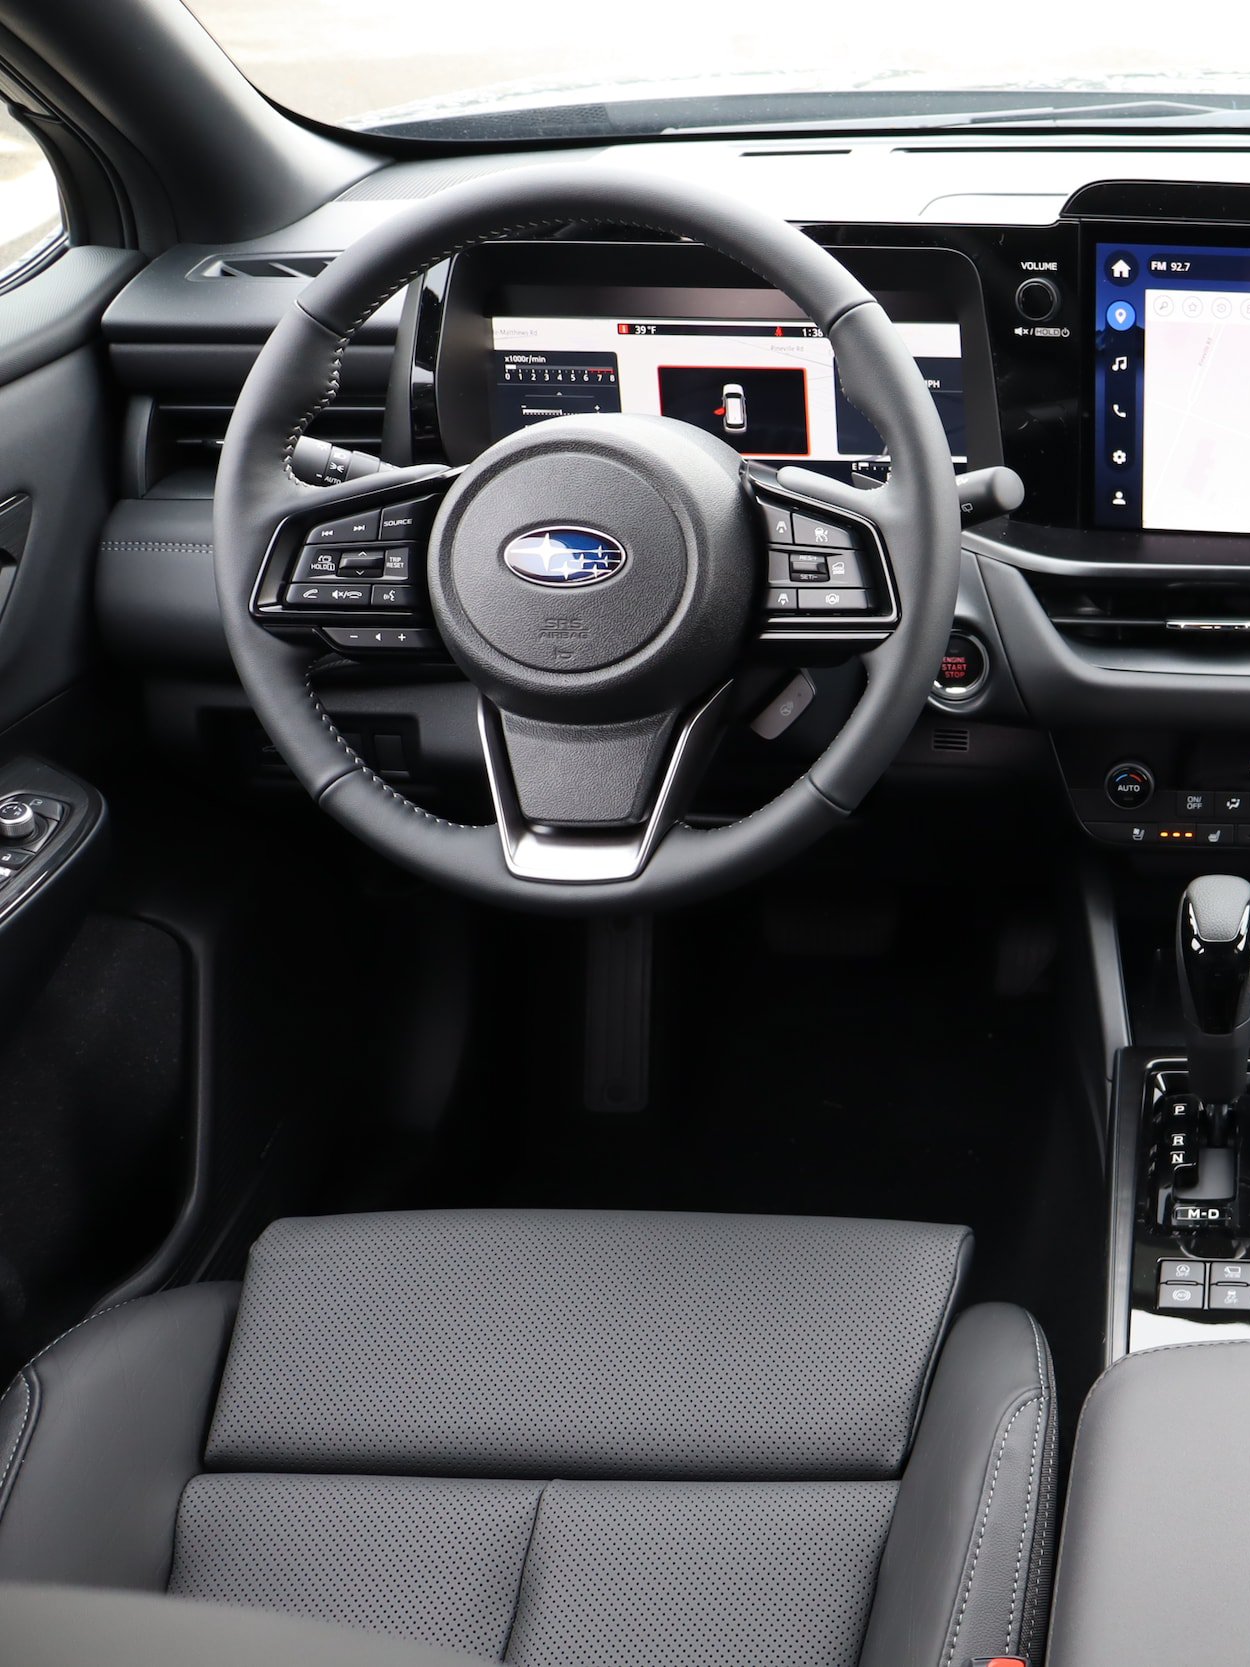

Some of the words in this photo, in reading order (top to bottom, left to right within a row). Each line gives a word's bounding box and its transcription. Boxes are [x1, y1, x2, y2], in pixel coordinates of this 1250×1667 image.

[1020, 261, 1058, 271] VOLUME
[1151, 261, 1167, 271] FM
[1170, 262, 1191, 272] 92.7
[1035, 327, 1061, 337] HOLD
[504, 373, 510, 381] 0
[518, 373, 523, 381] 1
[531, 373, 537, 381] 2
[544, 373, 550, 381] 3
[557, 373, 563, 381] 4
[570, 373, 576, 381] 5
[583, 373, 589, 381] 6
[597, 374, 603, 382] 7
[609, 374, 616, 382] 8
[383, 518, 413, 527] SOURCE
[942, 663, 967, 671] START
[944, 671, 966, 679] STOP
[1117, 784, 1141, 792] AUTO
[1186, 802, 1203, 810] OFF
[1174, 1105, 1186, 1115] P
[1172, 1136, 1184, 1146] R
[1171, 1153, 1184, 1164] N
[1187, 1208, 1220, 1220] M-D
